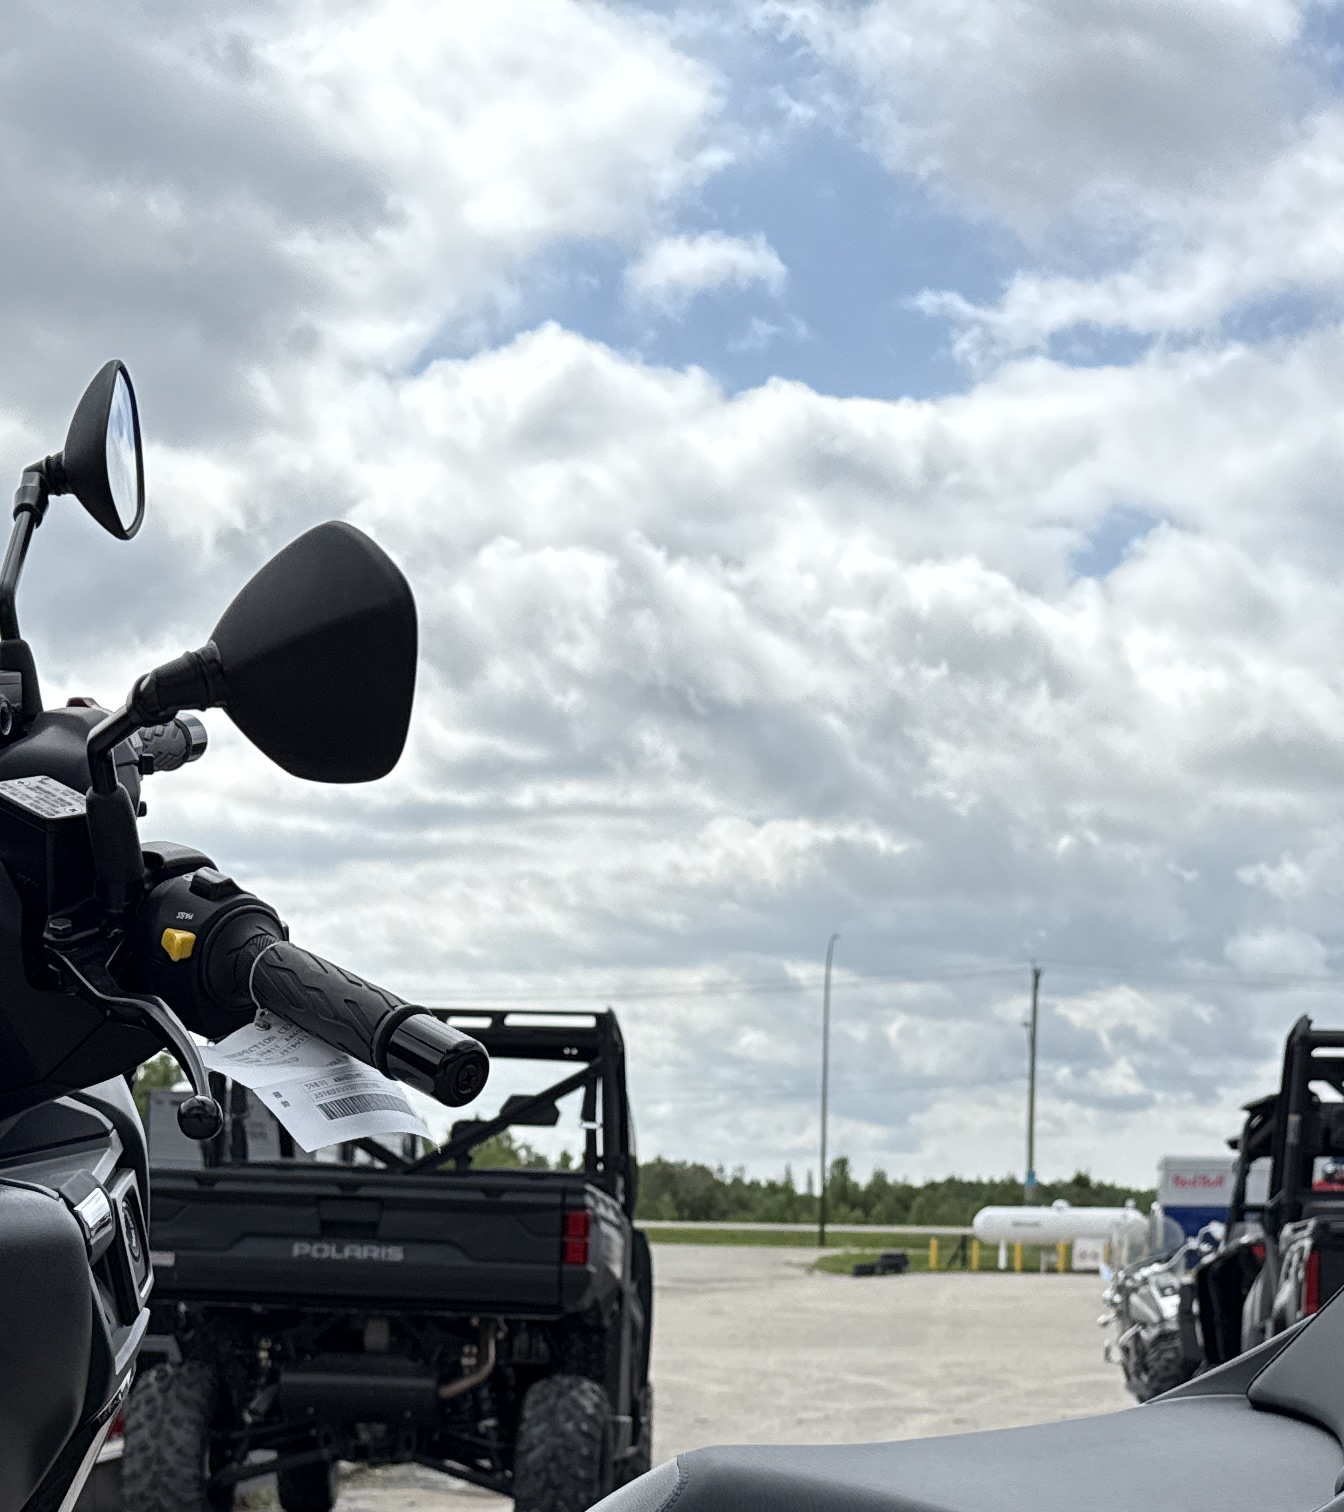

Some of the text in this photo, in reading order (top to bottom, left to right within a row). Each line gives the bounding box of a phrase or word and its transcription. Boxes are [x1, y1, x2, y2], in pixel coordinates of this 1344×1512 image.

[1171, 1172, 1225, 1189] Red Bull
[292, 1241, 404, 1262] POLARIS
